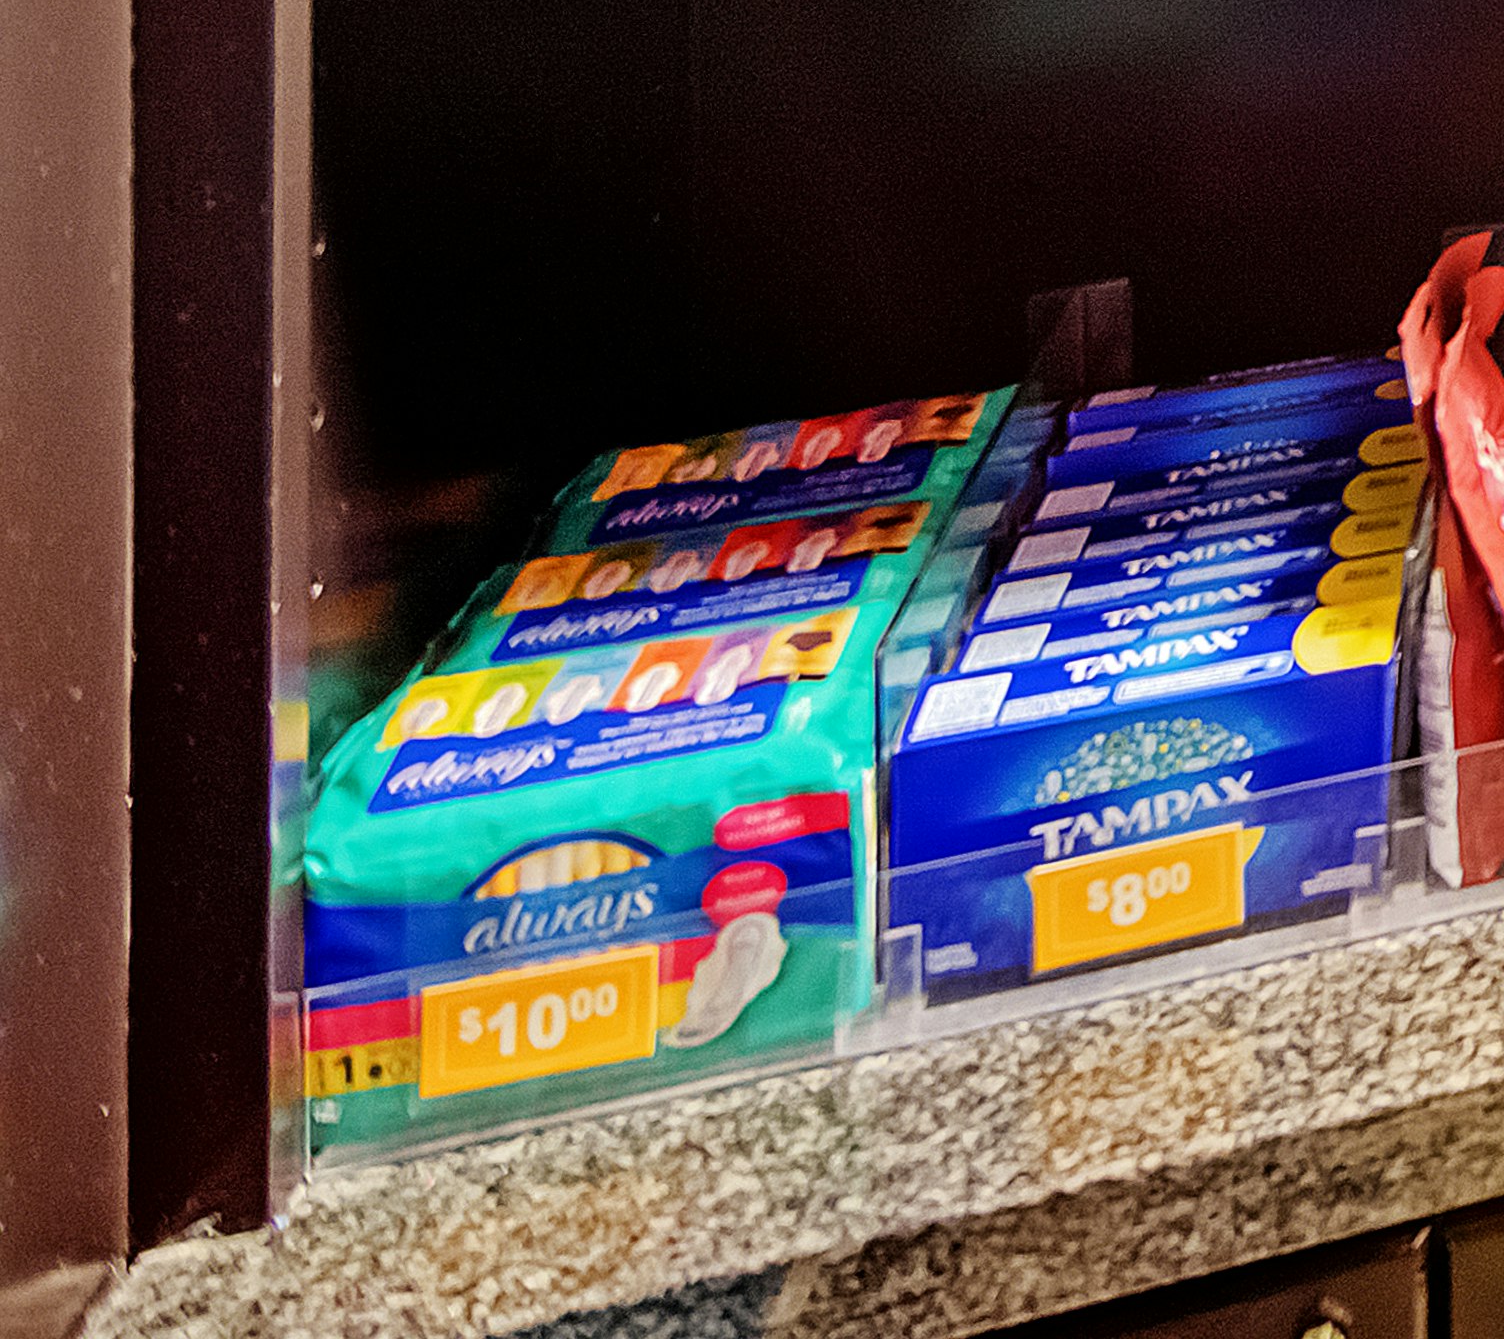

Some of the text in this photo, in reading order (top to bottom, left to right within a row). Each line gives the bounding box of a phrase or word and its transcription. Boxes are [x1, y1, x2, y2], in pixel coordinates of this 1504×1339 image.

[1122, 528, 1288, 578] TAMPAX
[1101, 578, 1274, 629] TAMPAX
[1064, 624, 1250, 685] TAMPAX
[1029, 770, 1257, 860] TAMPAX
[463, 883, 658, 955] always
